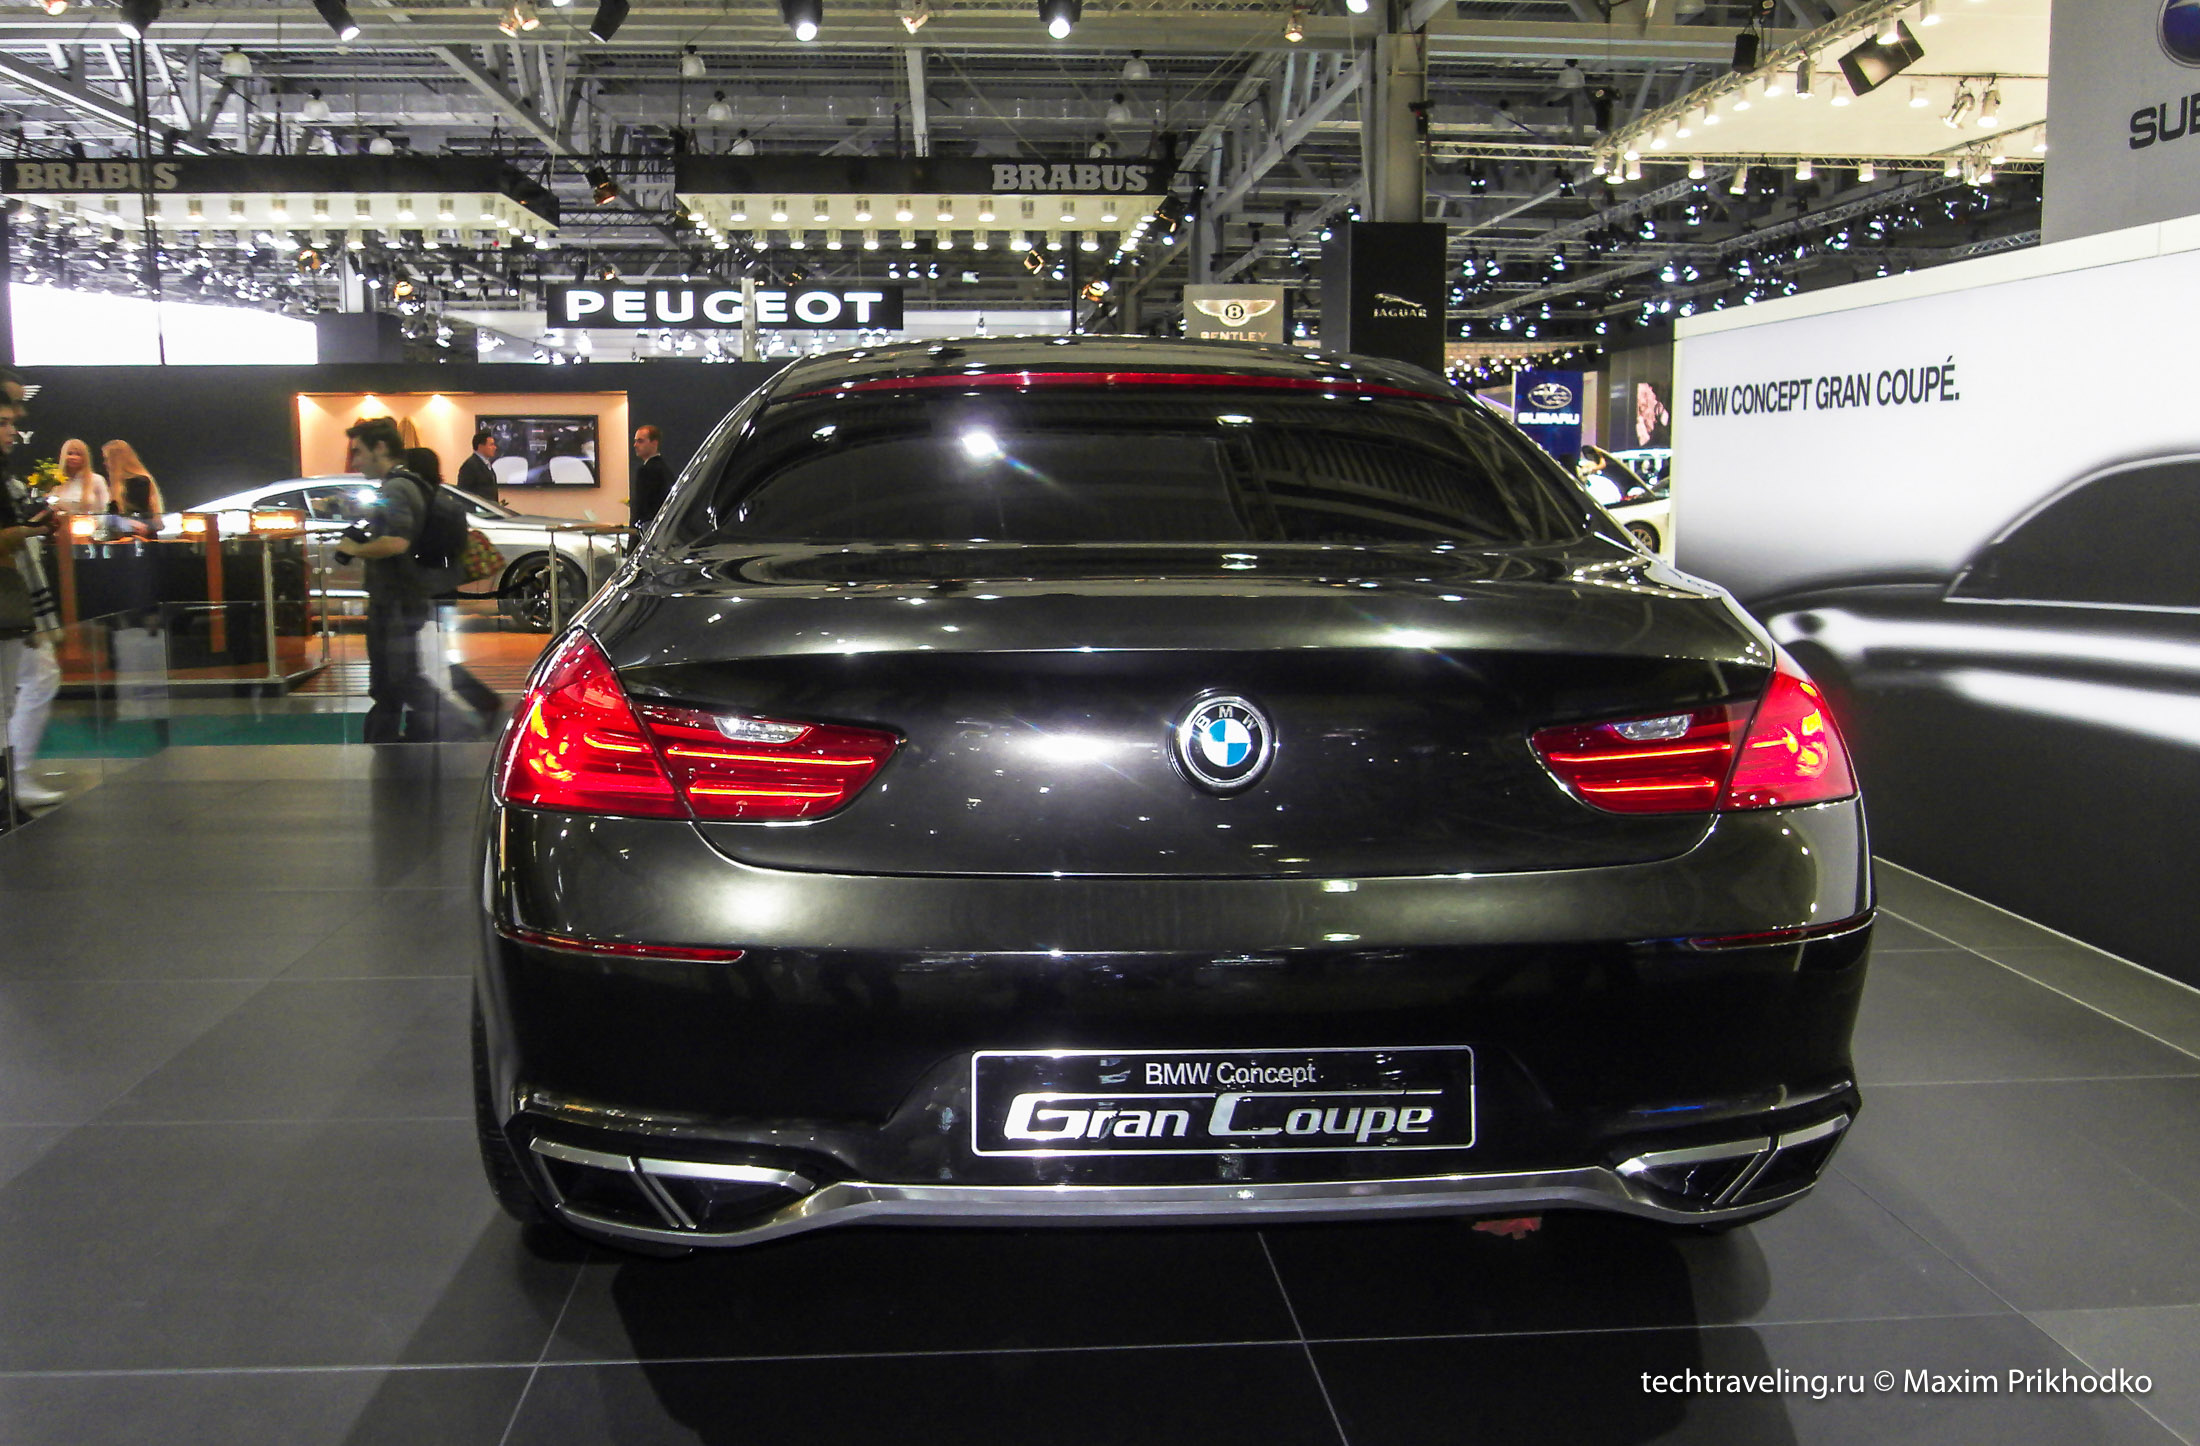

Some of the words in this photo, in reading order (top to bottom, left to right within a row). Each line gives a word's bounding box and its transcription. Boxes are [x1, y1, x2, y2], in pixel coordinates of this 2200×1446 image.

[992, 163, 1149, 192] BRABUS
[565, 289, 884, 324] PEUGEOT
[1373, 308, 1428, 318] JAGUAR
[1200, 331, 1268, 342] BENTLEY
[1692, 386, 1729, 417] BMW
[1731, 378, 1813, 415] CONCEPT
[1815, 372, 1871, 410] GRAN
[1876, 355, 1961, 406] COUPÉ.
[1517, 412, 1580, 425] SUBARU
[1194, 705, 1258, 733] BMW
[1145, 1062, 1211, 1086] BMW
[1215, 1061, 1317, 1089] Concept
[1003, 1092, 1190, 1141] Gran
[1207, 1091, 1434, 1142] Coupe
